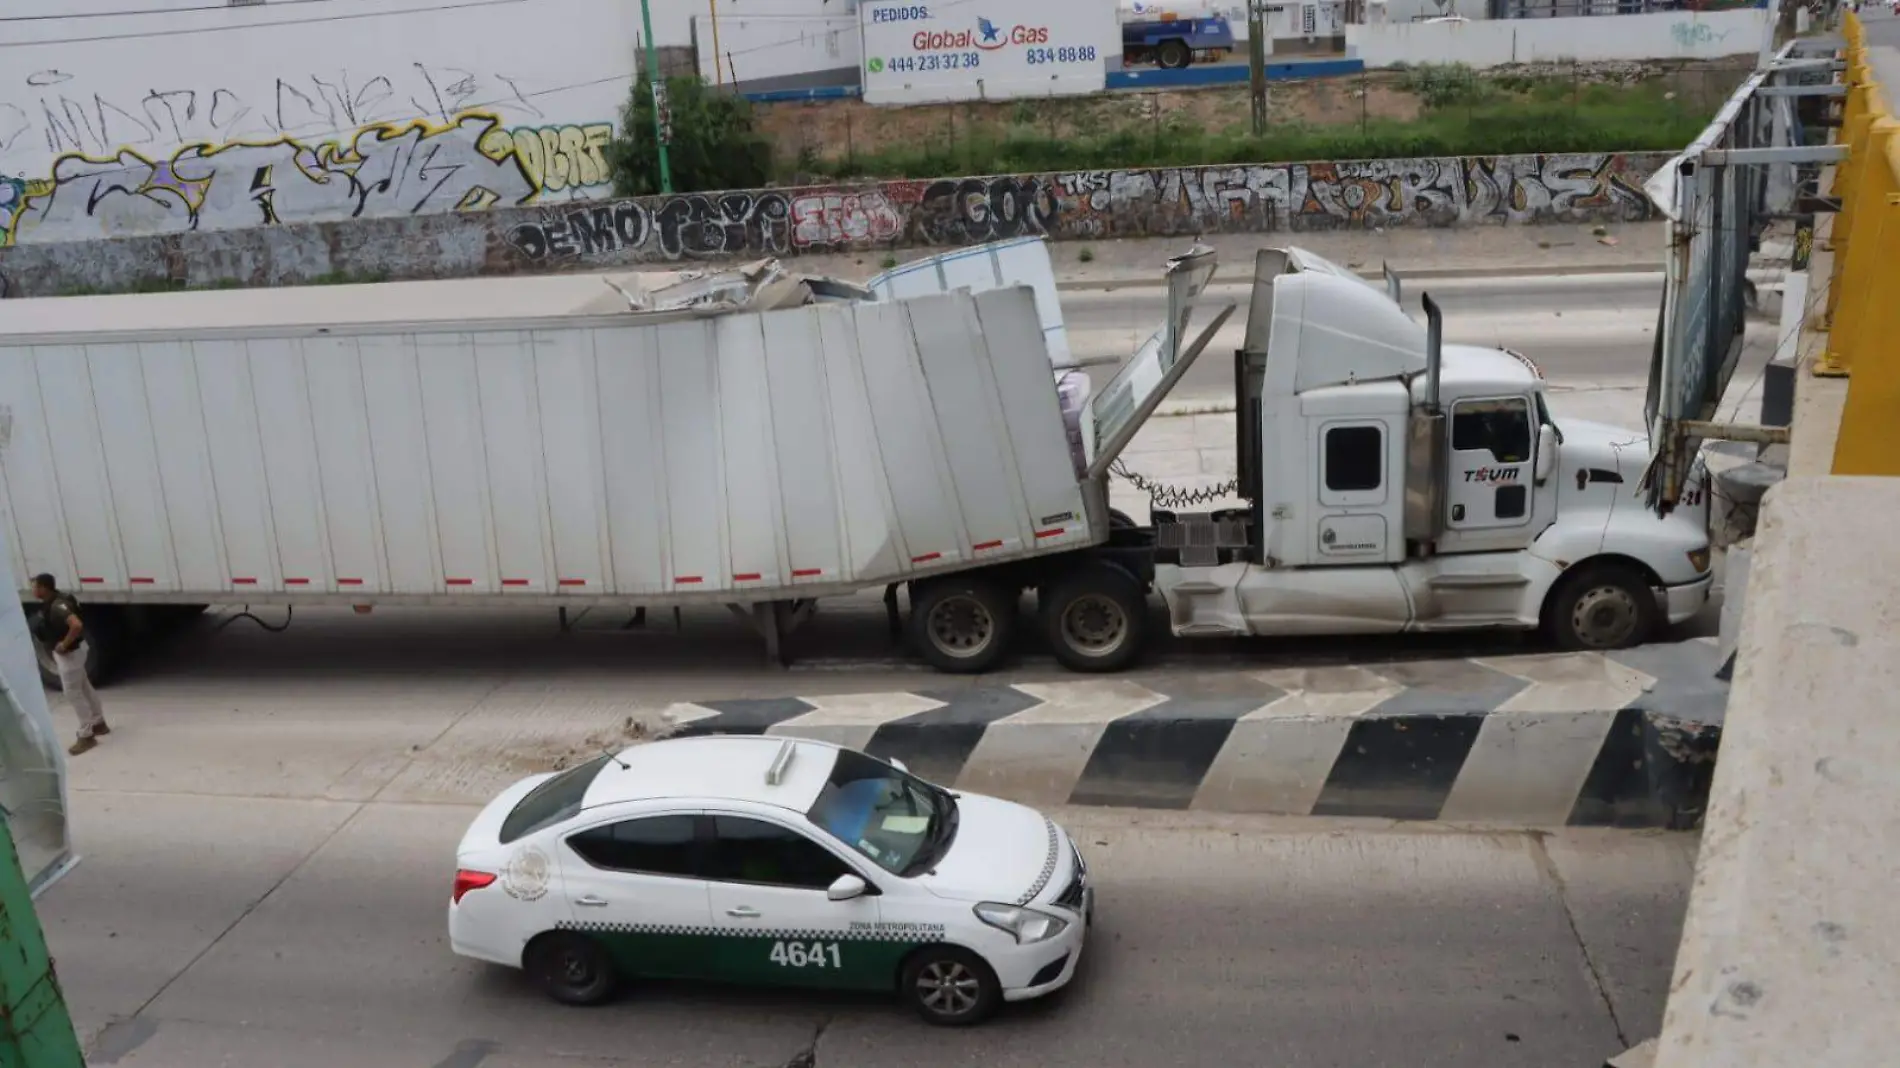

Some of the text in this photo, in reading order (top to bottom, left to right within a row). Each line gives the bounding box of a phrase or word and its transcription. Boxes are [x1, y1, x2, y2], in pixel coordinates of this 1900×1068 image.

[873, 6, 928, 22] PEDIDOS
[912, 25, 1049, 51] Global Gas
[770, 941, 841, 968] 4641
